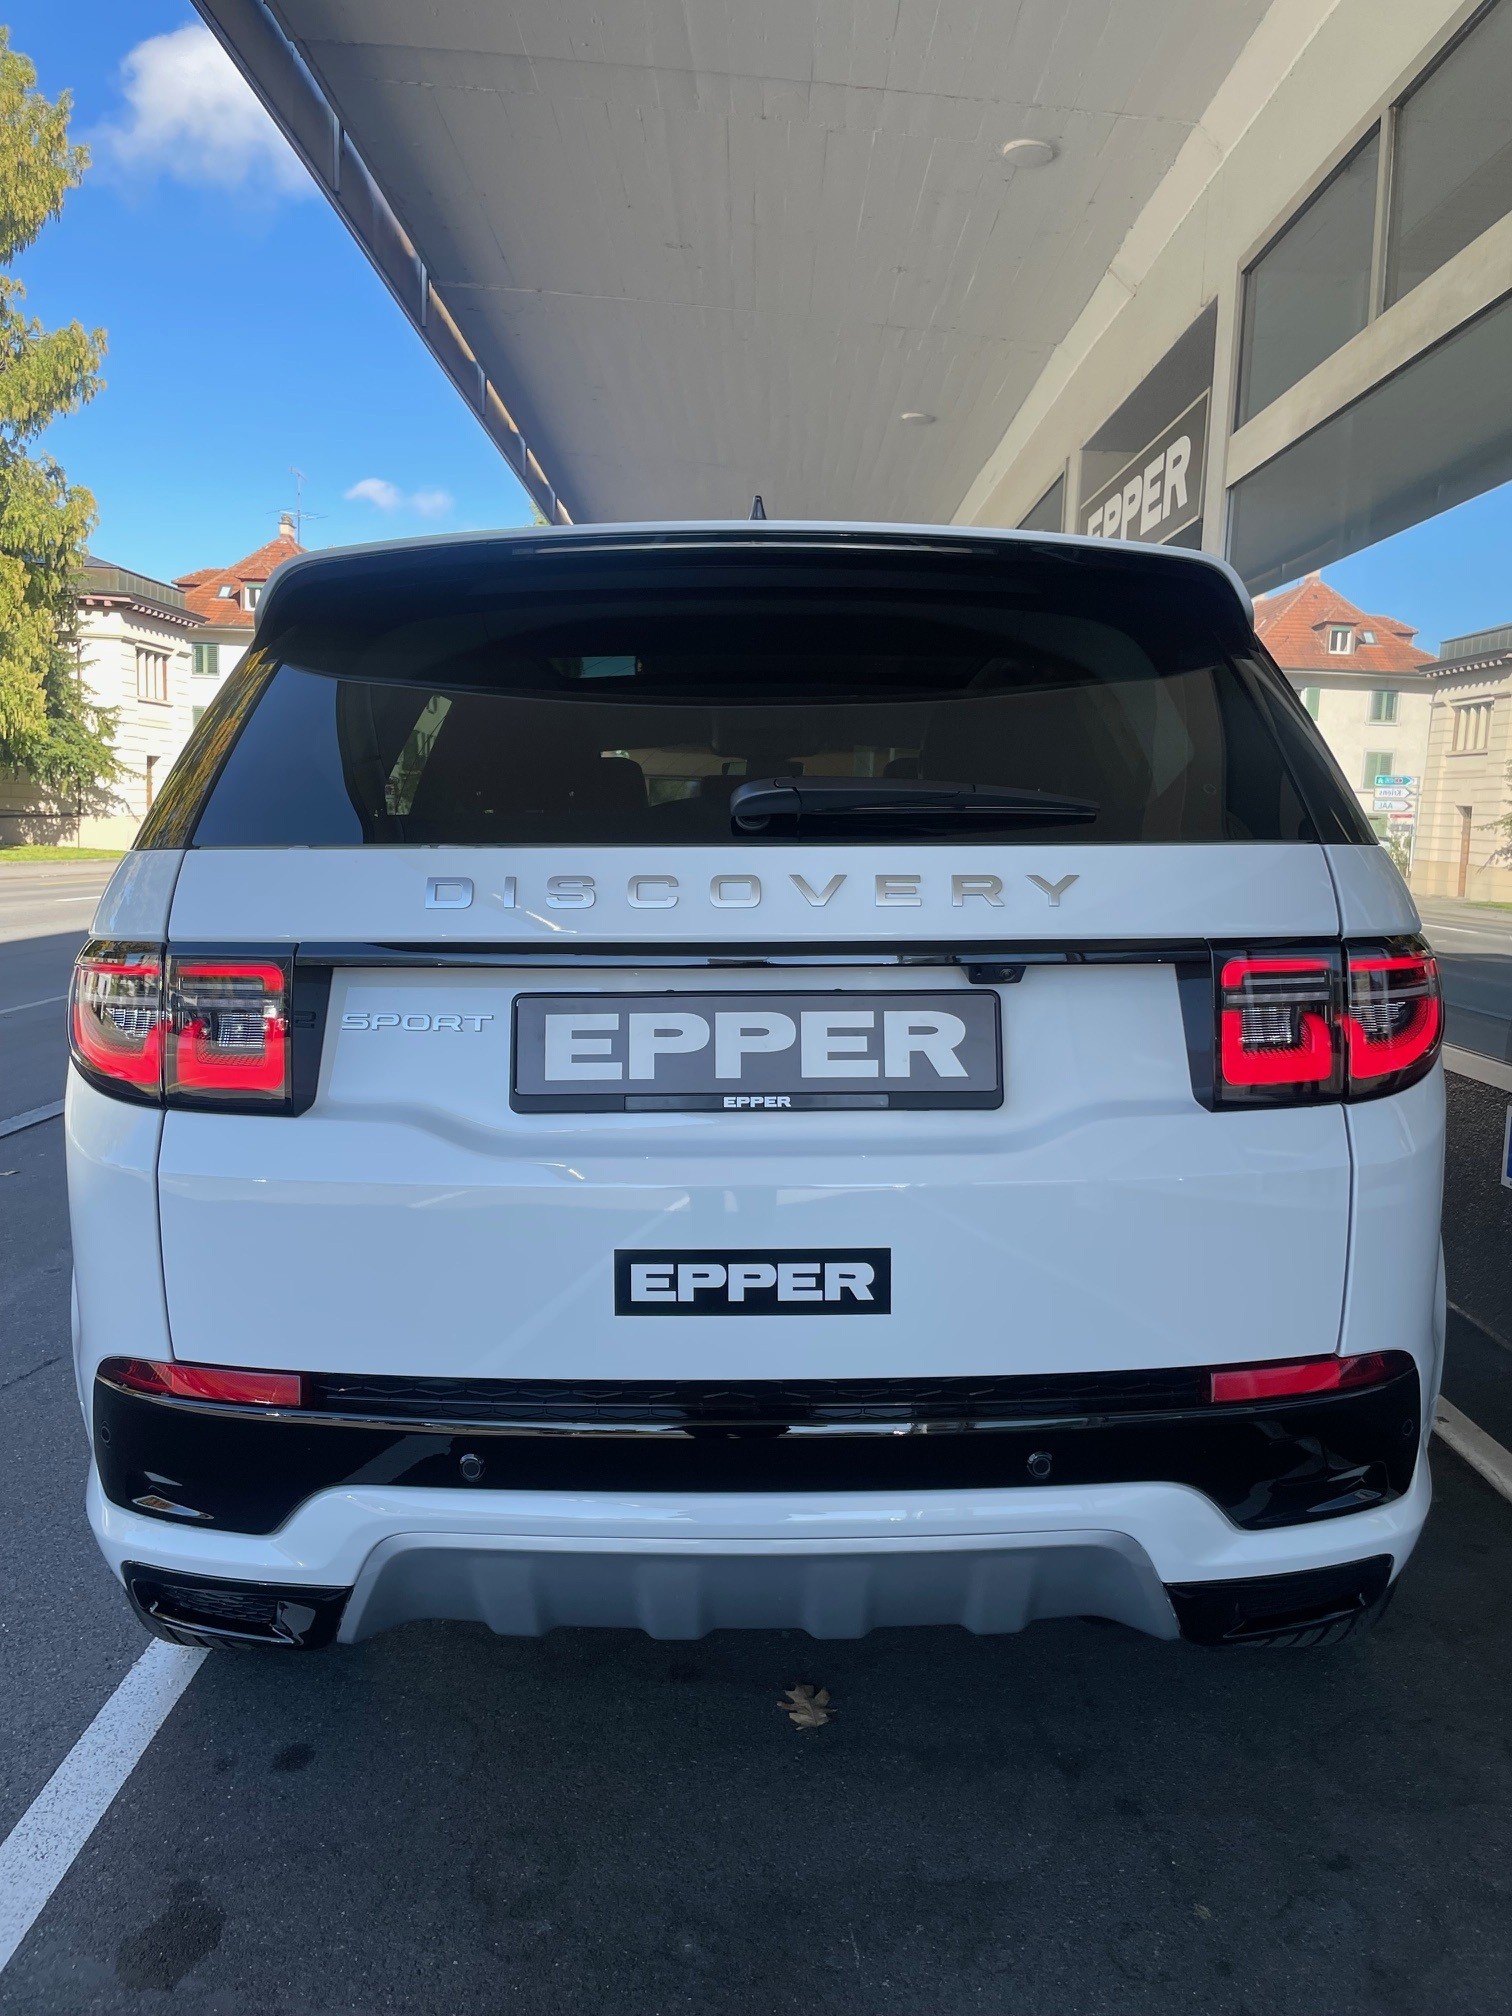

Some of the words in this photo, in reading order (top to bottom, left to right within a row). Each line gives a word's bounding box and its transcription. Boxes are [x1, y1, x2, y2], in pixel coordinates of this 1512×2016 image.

[424, 874, 1080, 910] DISCOVERY
[341, 1013, 494, 1032] SPORT
[544, 1010, 970, 1081] EPPER
[723, 1096, 792, 1108] EPPER
[630, 1262, 875, 1302] EPPER
